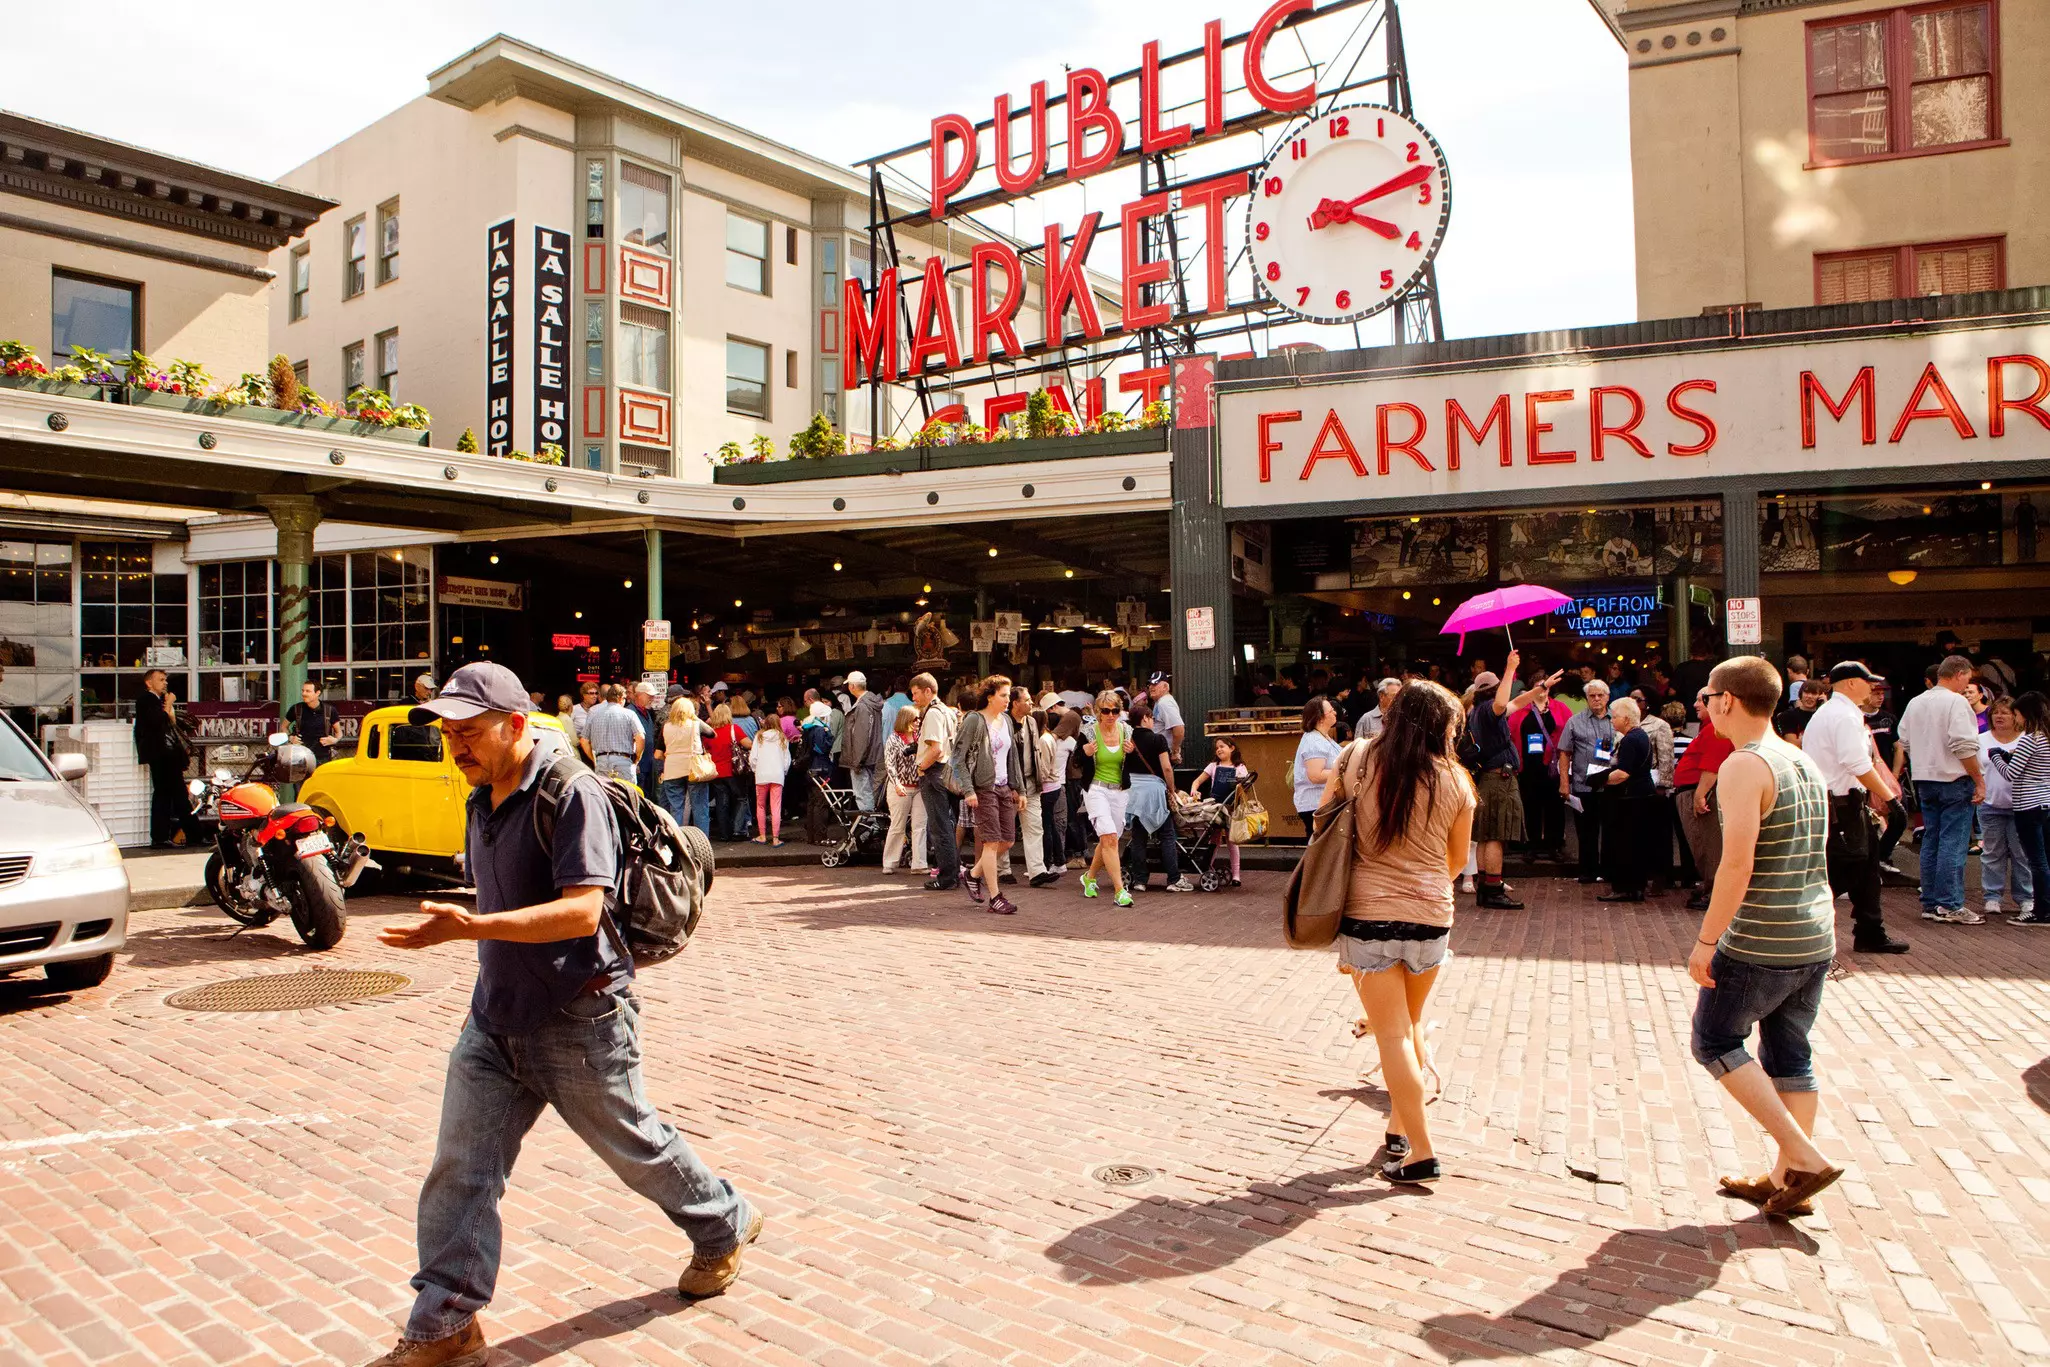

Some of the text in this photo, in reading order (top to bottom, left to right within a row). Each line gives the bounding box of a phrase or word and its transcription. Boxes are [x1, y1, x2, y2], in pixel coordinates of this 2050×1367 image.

[931, 0, 1319, 219] PUBLIC
[1329, 116, 1350, 138] 12
[1377, 118, 1384, 138] 1
[1291, 138, 1306, 160] 11
[1406, 142, 1420, 162] 2
[1264, 176, 1283, 197] 10
[1418, 183, 1432, 204] 3
[1256, 222, 1269, 241] 9
[1405, 231, 1422, 251] 4
[491, 230, 509, 270] LA
[1266, 261, 1281, 281] 8
[1380, 269, 1394, 289] 5
[844, 173, 1249, 390] MARKET
[1296, 286, 1311, 306] 7
[1335, 290, 1351, 309] 6
[490, 276, 510, 384] SALLE
[539, 231, 565, 453] LA SALLE HO
[1257, 378, 1719, 483] FARMERS
[1799, 354, 2050, 449] MAR
[1730, 600, 1742, 609] NO
[1567, 614, 1650, 629] VIEWPOINT
[1731, 611, 1756, 619] STOPS
[200, 718, 271, 738] MARKET
